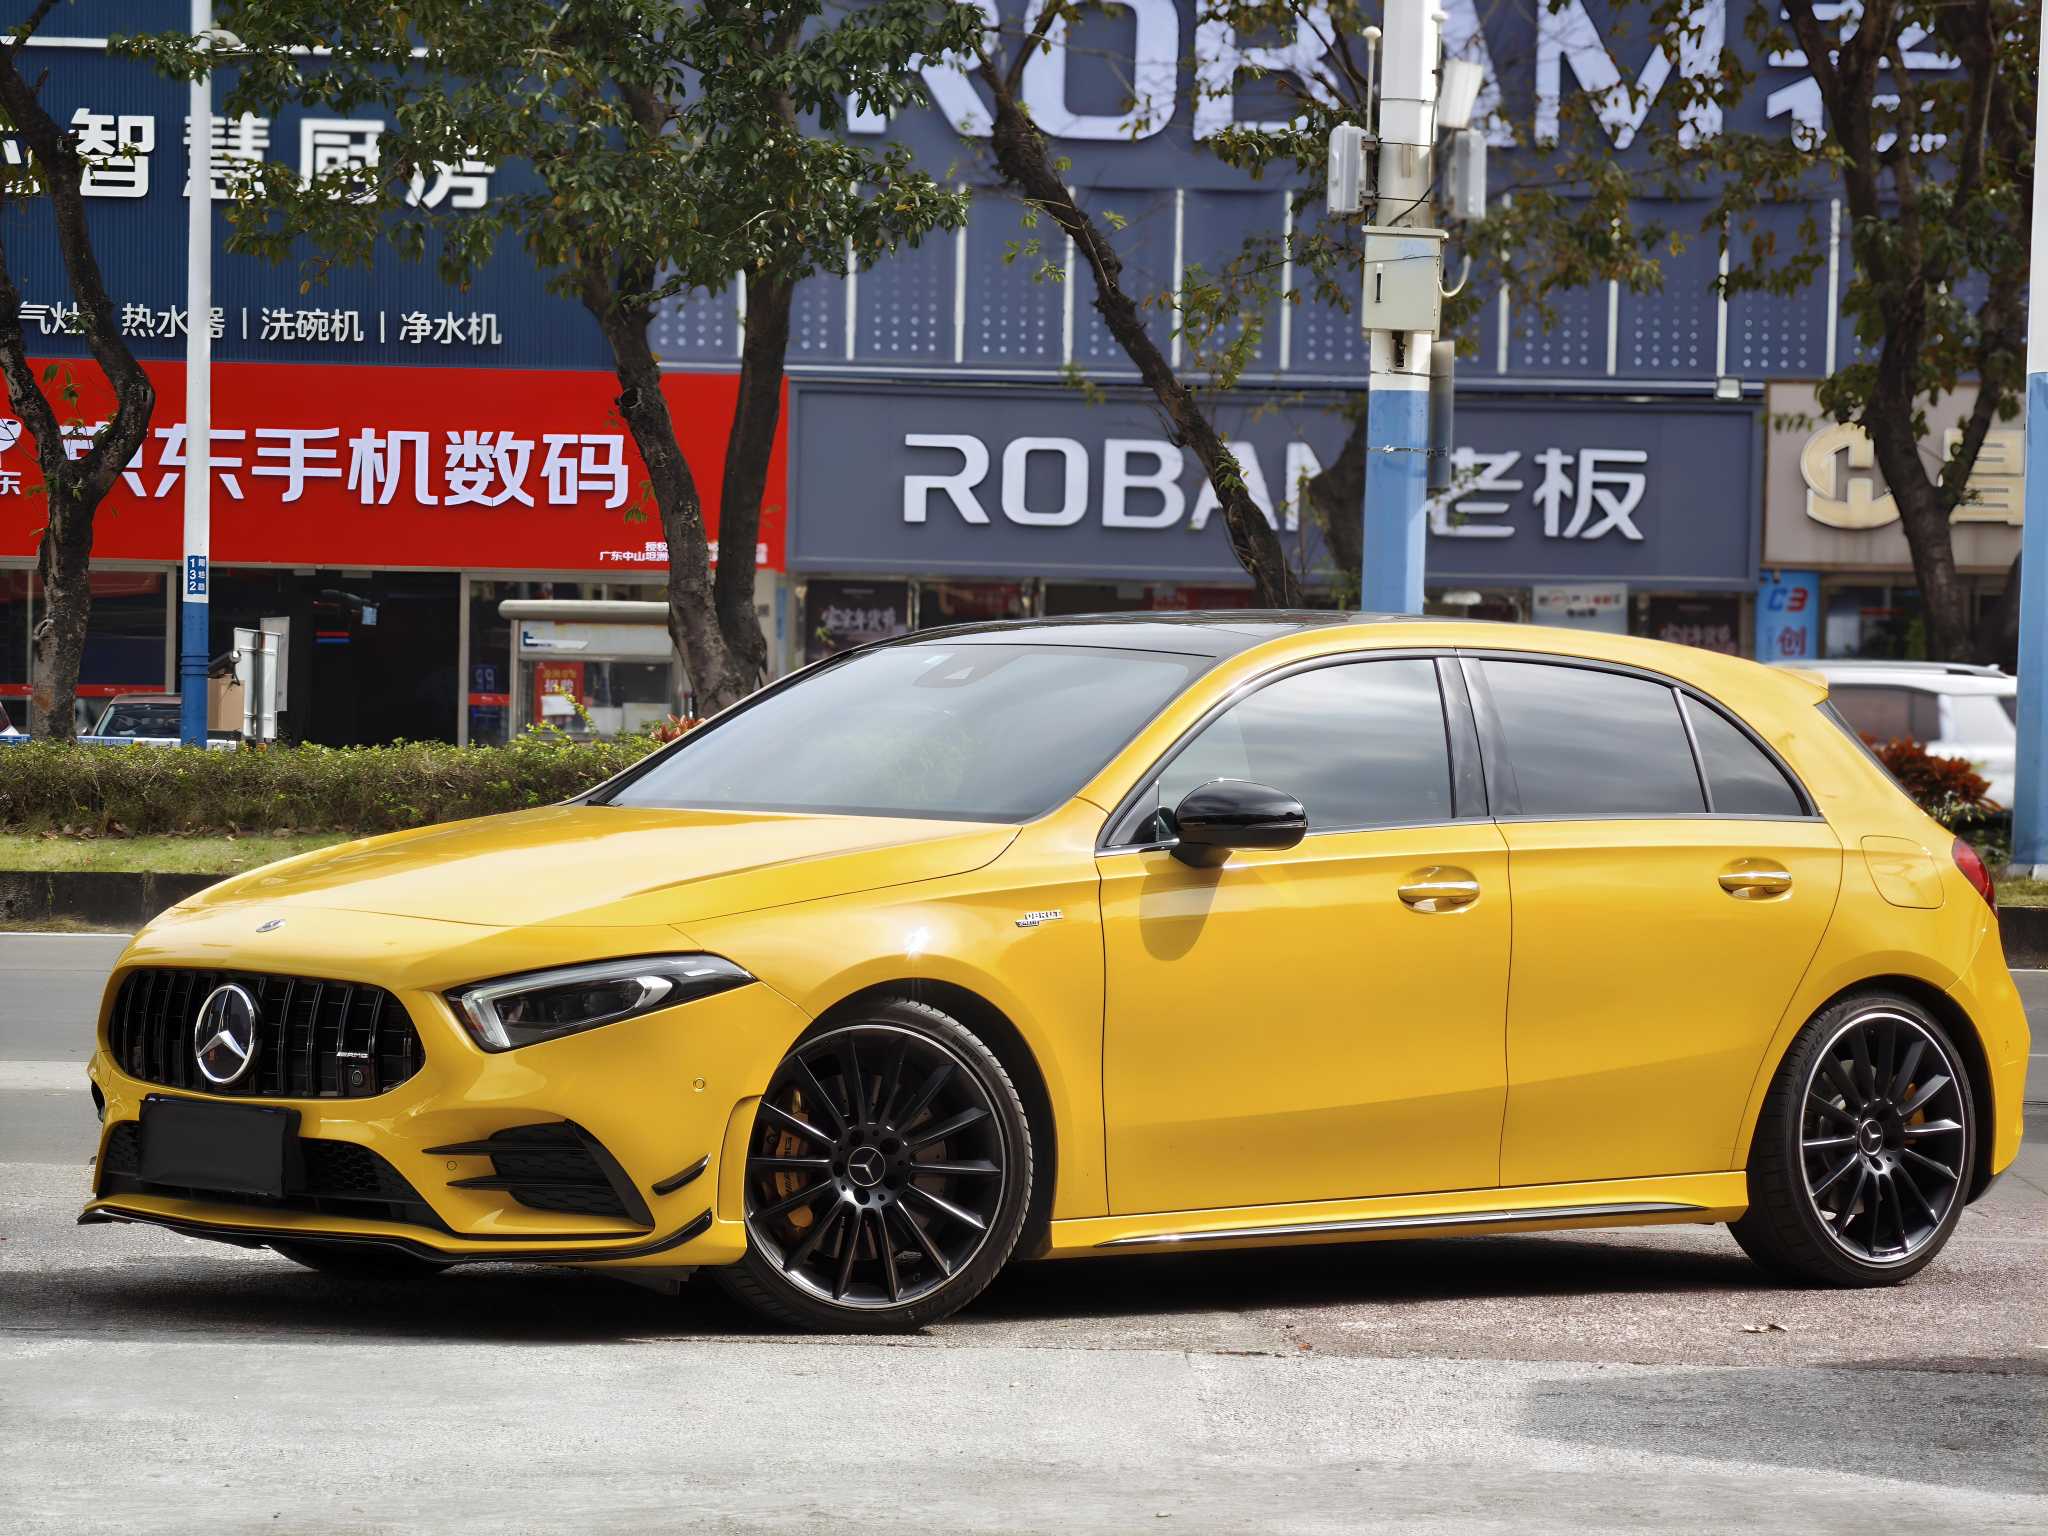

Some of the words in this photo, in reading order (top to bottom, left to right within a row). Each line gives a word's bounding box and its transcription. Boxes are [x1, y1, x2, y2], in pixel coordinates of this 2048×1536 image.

[260, 307, 365, 342] 洗碗机
[399, 311, 502, 345] 净水机
[1425, 447, 1648, 540] 老板
